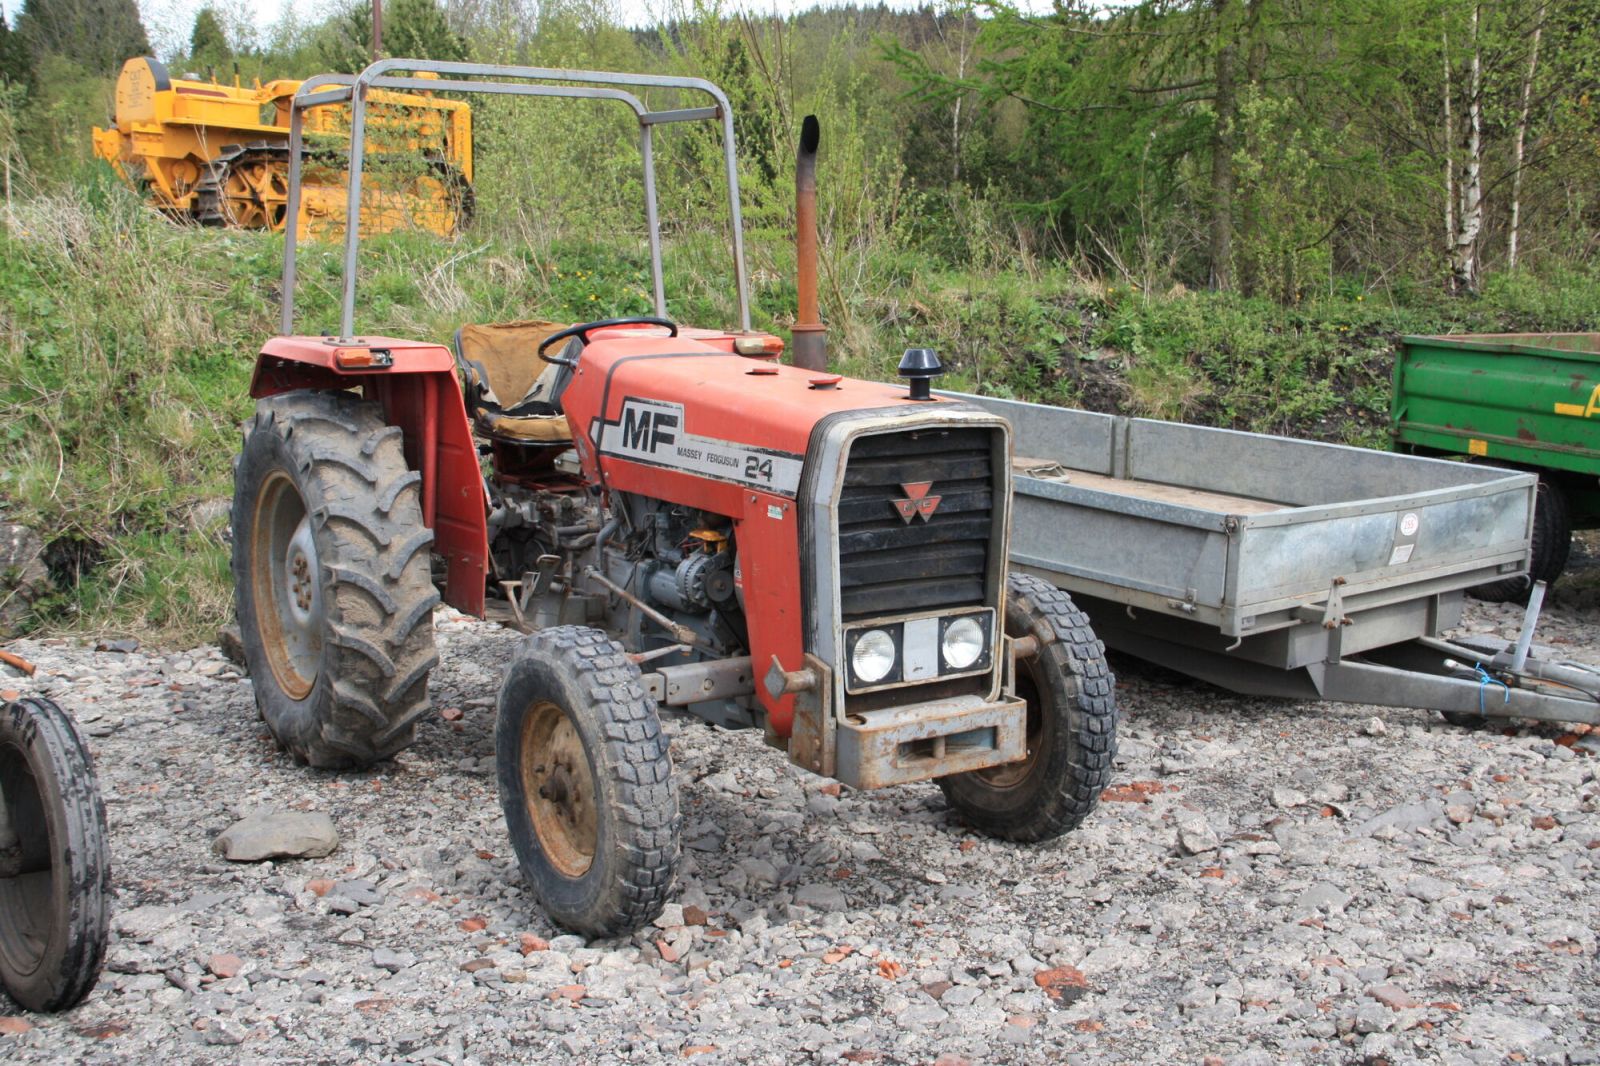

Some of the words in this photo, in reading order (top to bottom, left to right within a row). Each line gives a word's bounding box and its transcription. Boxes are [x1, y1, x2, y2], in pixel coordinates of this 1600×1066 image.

[622, 407, 679, 453] MF
[677, 447, 702, 460] MASSEY
[706, 453, 740, 468] FERGUSON
[745, 456, 773, 482] 24
